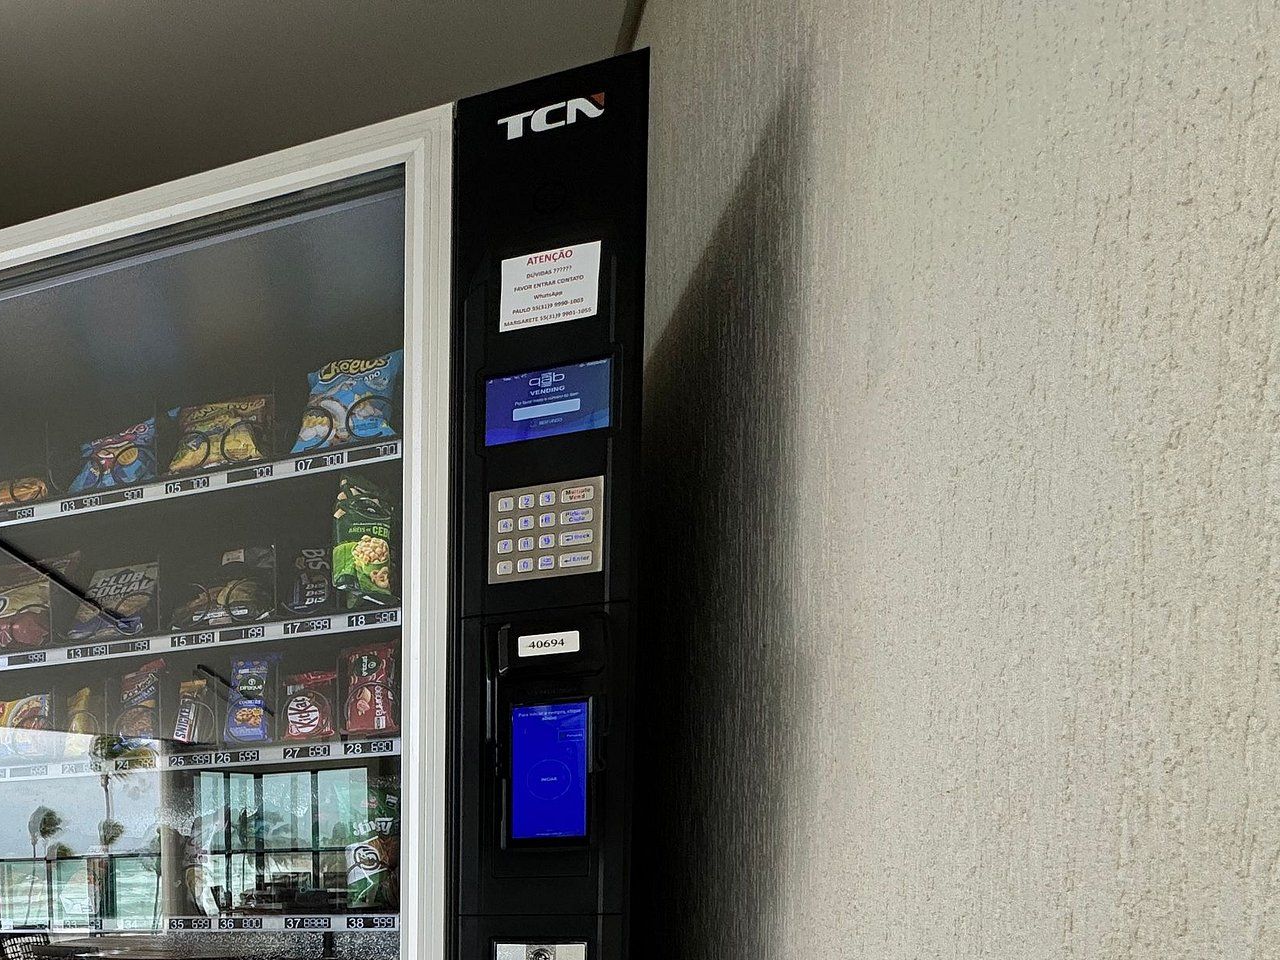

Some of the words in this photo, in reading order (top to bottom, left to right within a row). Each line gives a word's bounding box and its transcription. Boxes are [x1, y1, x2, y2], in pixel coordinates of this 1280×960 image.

[497, 92, 605, 140] TCN
[526, 249, 573, 266] ATENÇÃO
[533, 279, 556, 289] ENTRAR
[556, 274, 584, 284] CONTATO
[529, 385, 565, 396] VENDING
[297, 459, 313, 471] 07
[167, 482, 181, 493] 05
[62, 501, 75, 511] 03
[96, 571, 145, 588] CLUB
[86, 579, 152, 598] SOCIAL
[351, 615, 365, 627] 18
[286, 623, 301, 634] 17
[173, 636, 187, 647] 15
[528, 638, 565, 649] 40694
[70, 648, 82, 658] 13
[285, 747, 300, 759] 27
[346, 743, 362, 754] 28
[170, 756, 184, 766] 25
[216, 753, 231, 764] 26
[116, 761, 129, 770] 24
[170, 919, 184, 929] 35
[220, 919, 234, 928] 36
[287, 919, 300, 928] 37
[349, 918, 364, 928] 38
